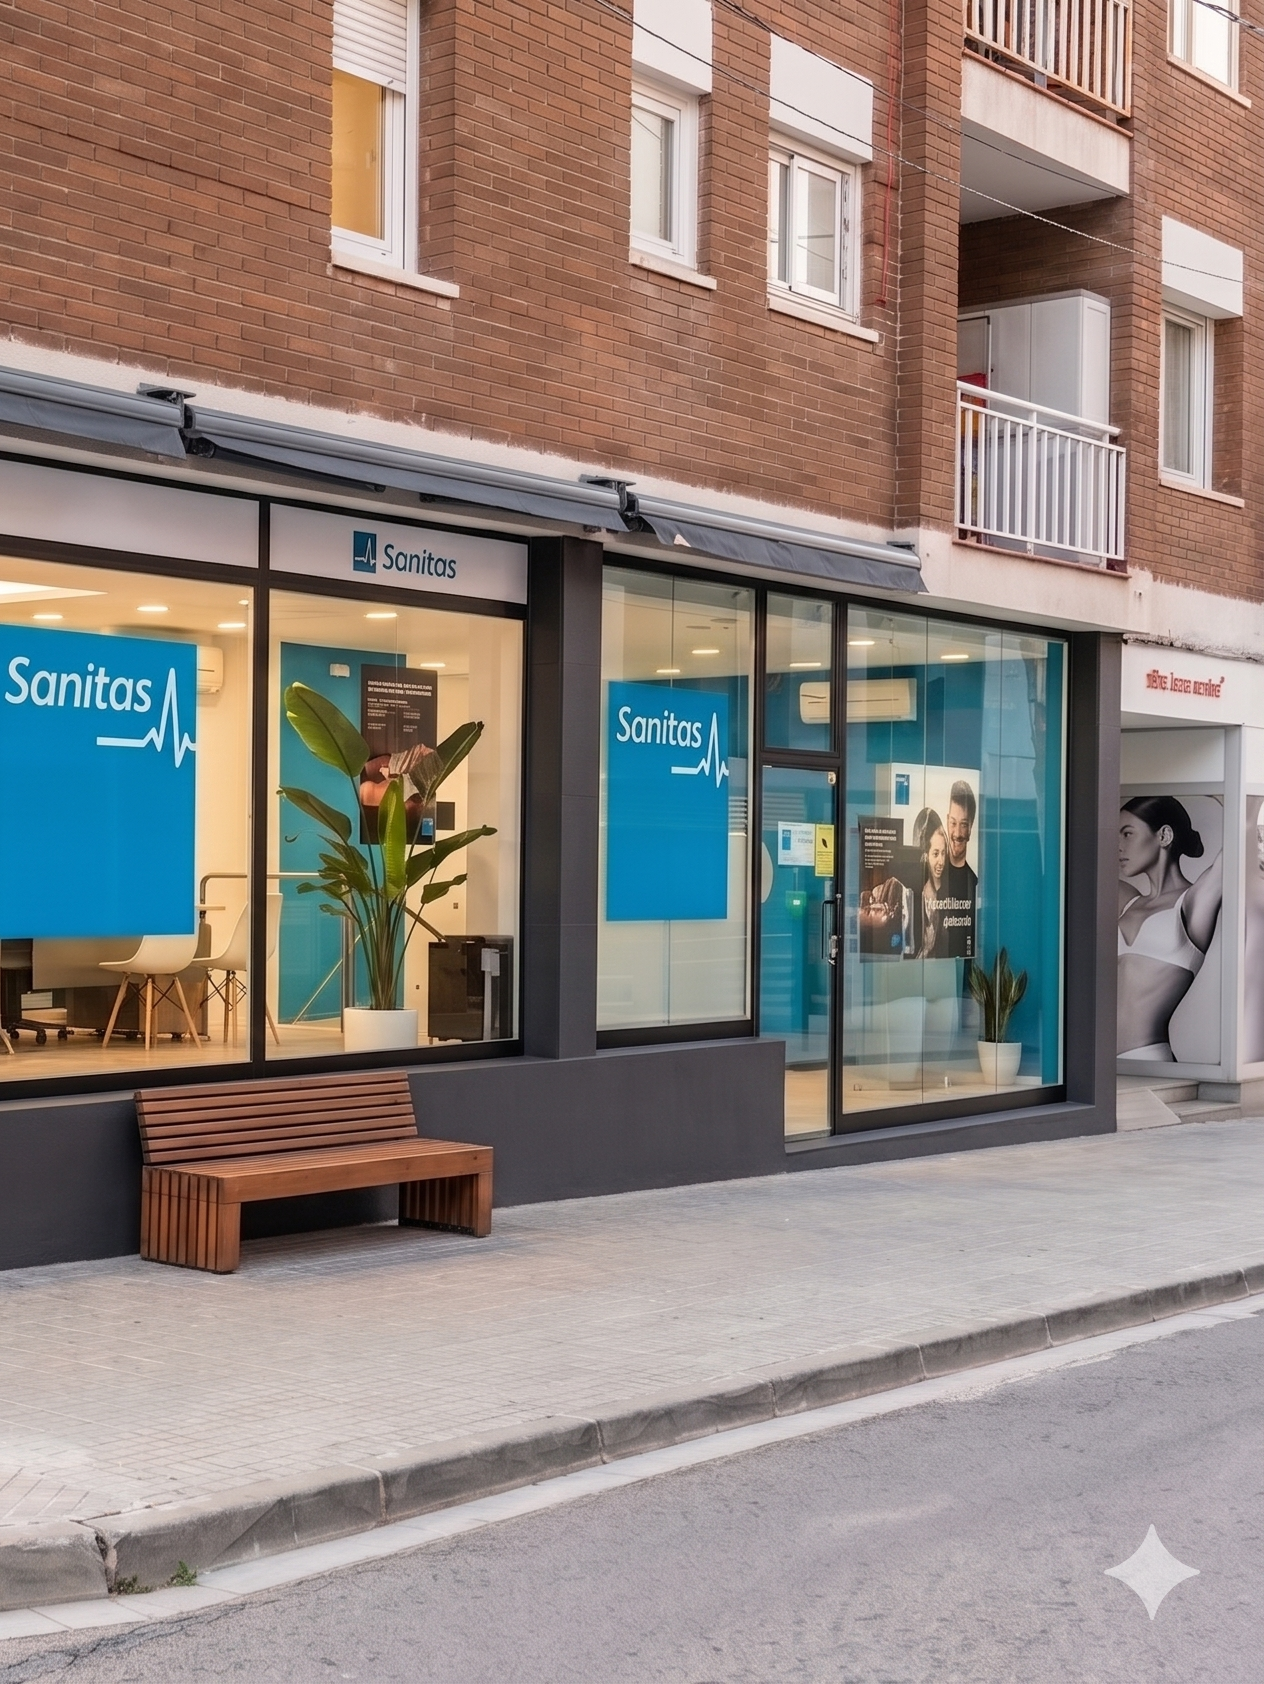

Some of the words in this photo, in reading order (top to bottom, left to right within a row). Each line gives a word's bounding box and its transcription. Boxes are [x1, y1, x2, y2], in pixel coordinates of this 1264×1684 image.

[382, 543, 457, 579] Sanitas
[4, 656, 152, 713] Sanitas
[616, 706, 702, 748] Sanitas
